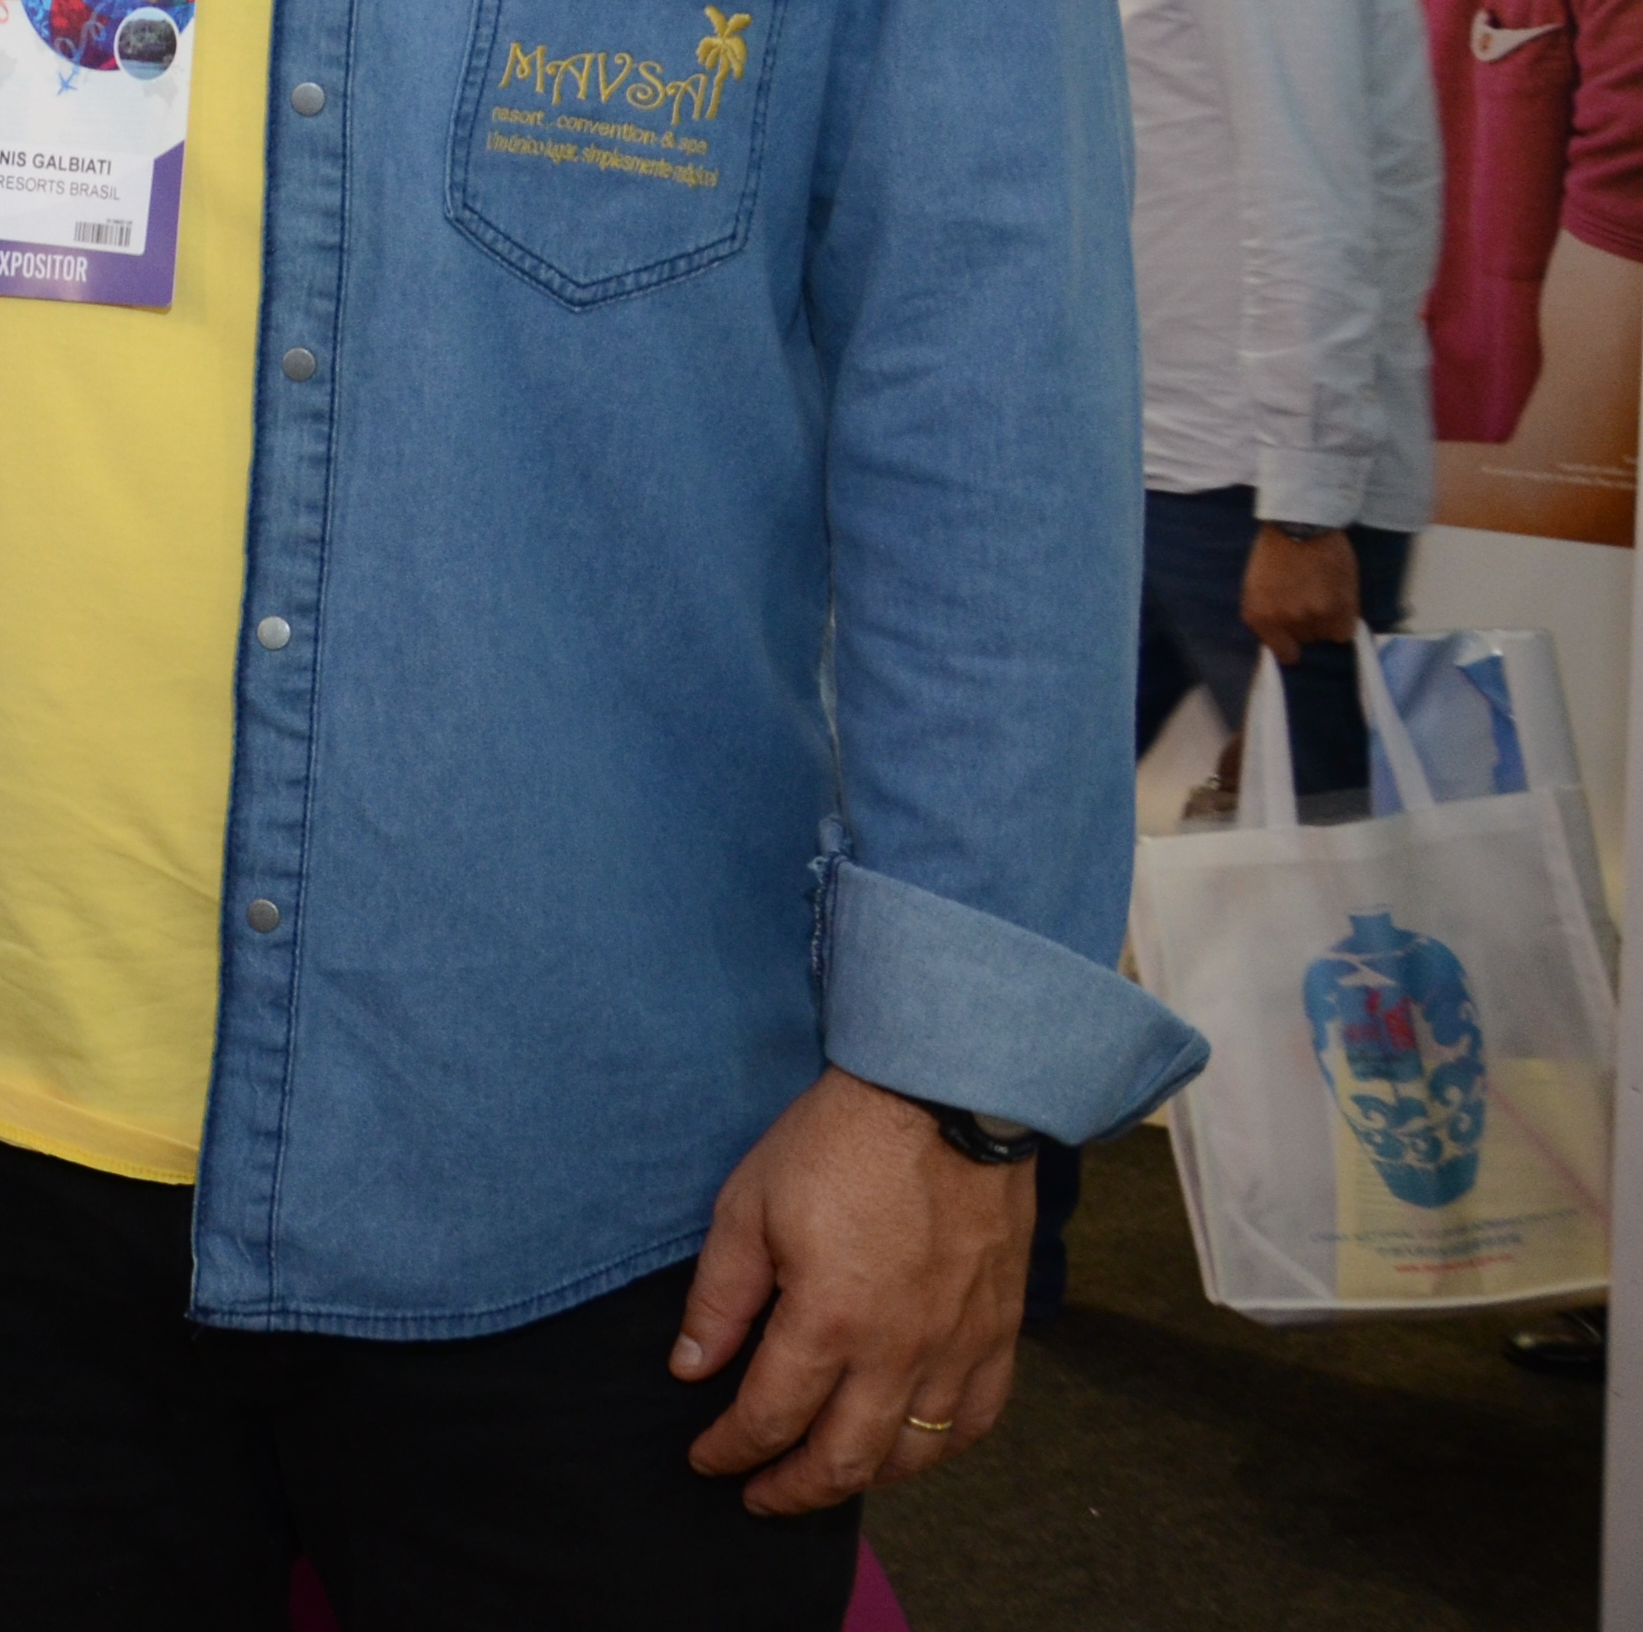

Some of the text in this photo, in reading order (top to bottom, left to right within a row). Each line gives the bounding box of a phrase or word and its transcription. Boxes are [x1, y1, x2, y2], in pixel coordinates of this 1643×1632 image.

[499, 42, 709, 125] MAVSA
[32, 153, 112, 176] GALBIATI
[69, 182, 121, 201] BRASIL
